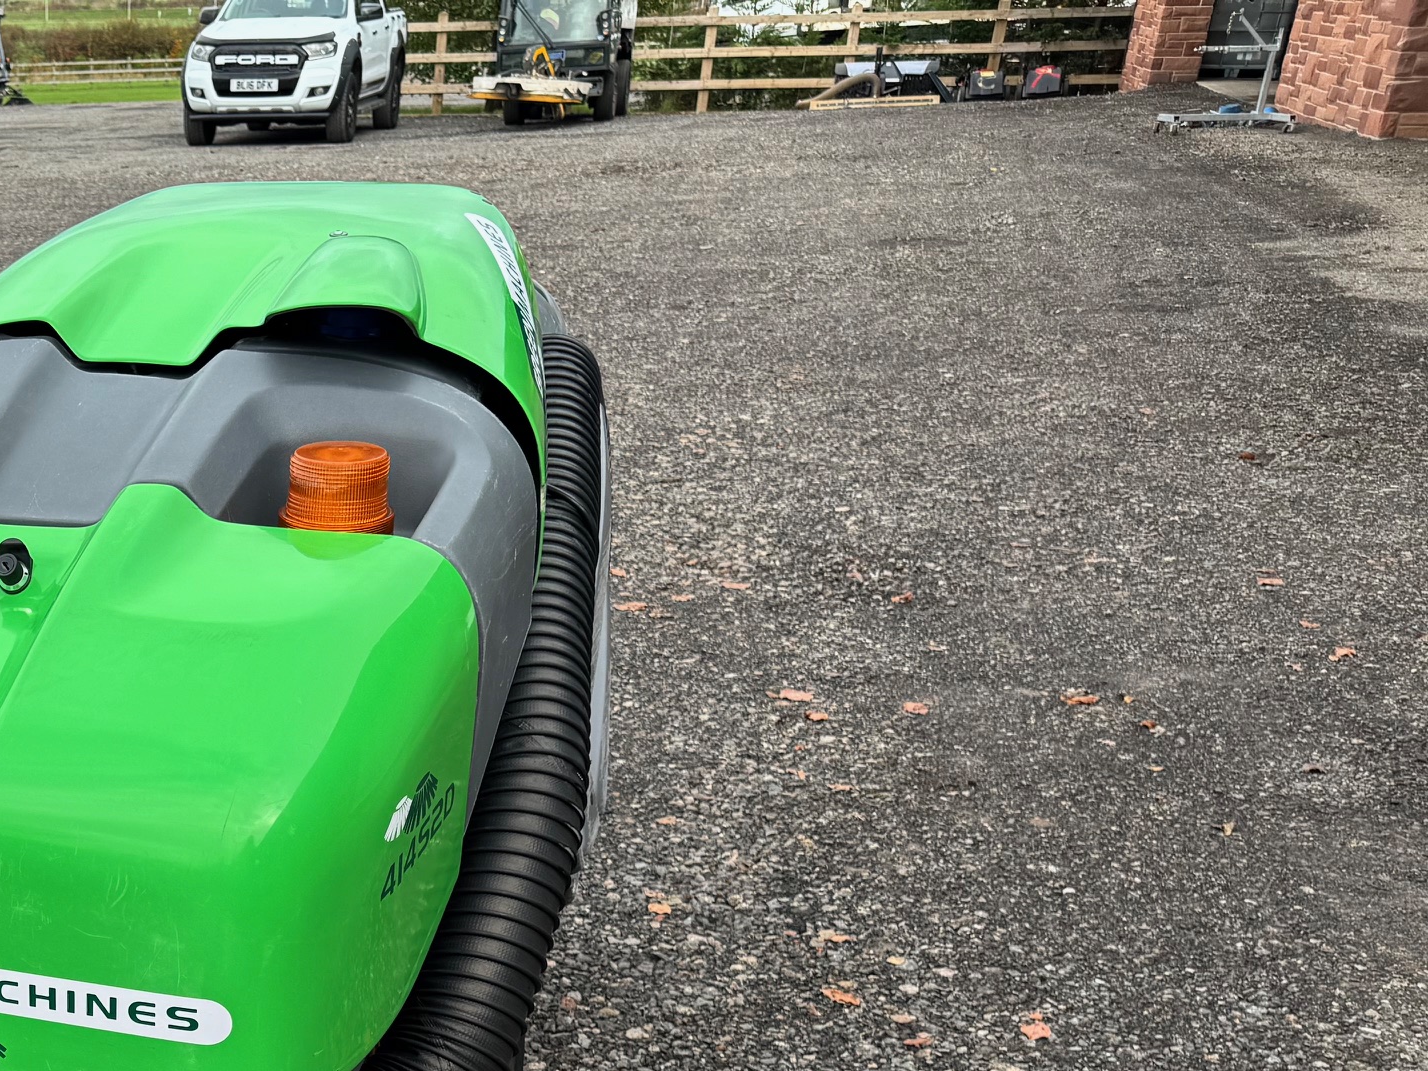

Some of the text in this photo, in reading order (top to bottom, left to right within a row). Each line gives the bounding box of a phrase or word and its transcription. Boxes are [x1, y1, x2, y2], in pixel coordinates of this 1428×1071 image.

[215, 54, 299, 66] FORD
[476, 219, 530, 316] MACHINES
[380, 782, 455, 902] 414520
